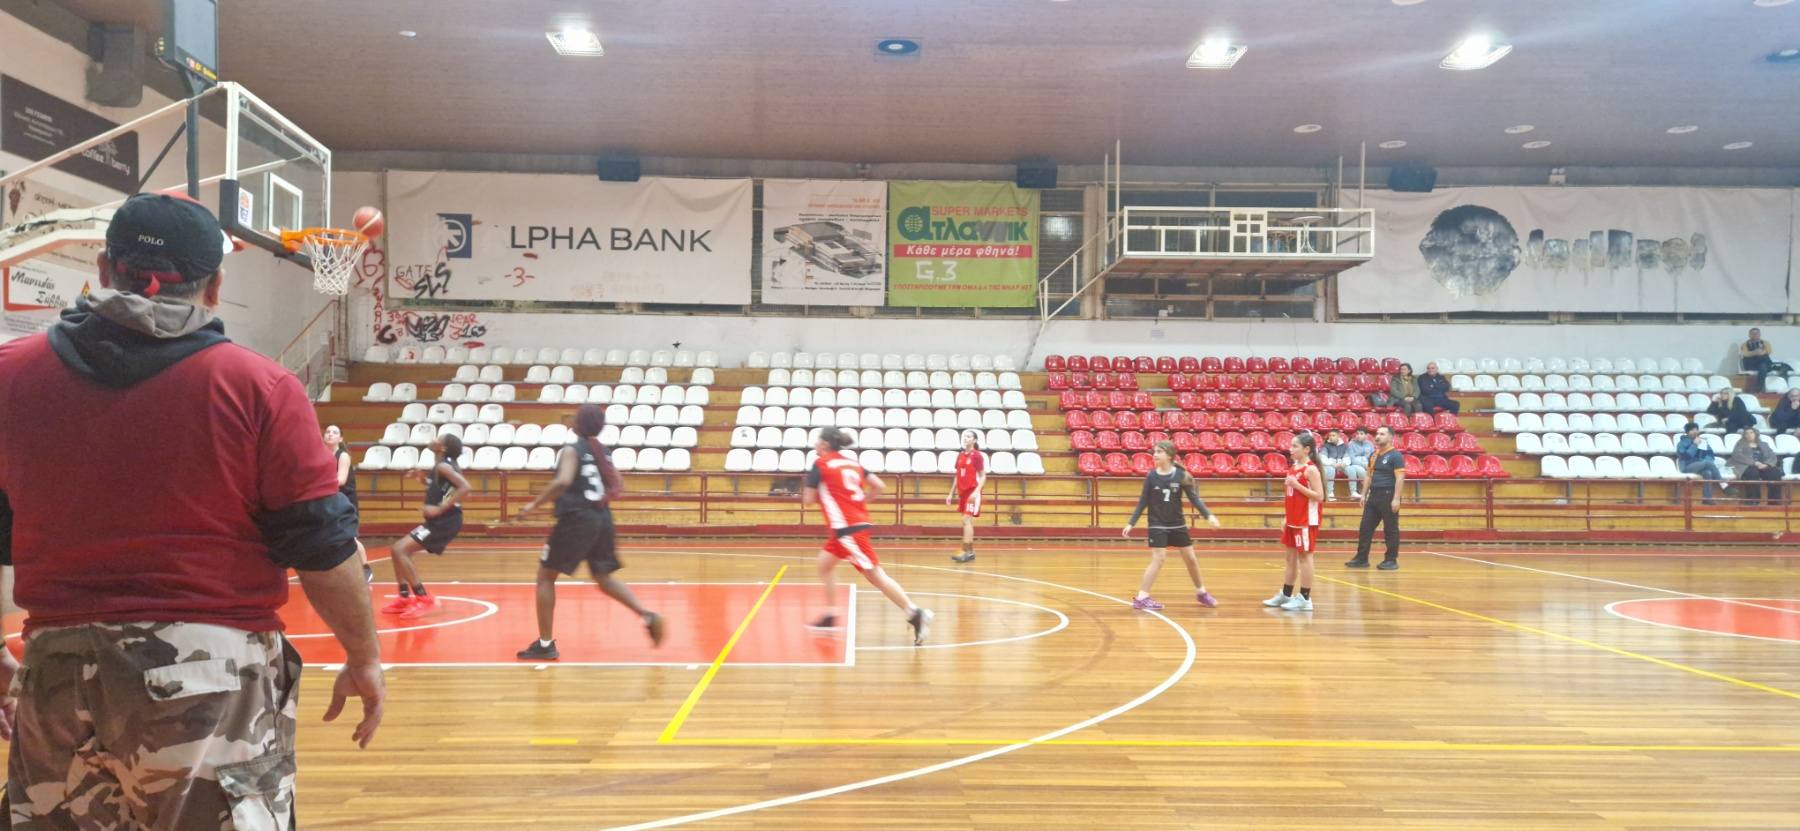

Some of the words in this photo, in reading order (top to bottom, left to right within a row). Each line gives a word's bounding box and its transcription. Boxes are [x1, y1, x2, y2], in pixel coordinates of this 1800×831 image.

[931, 206, 971, 217] SUPER
[974, 206, 1029, 217] MARKETS
[138, 234, 164, 246] POLO
[610, 227, 713, 253] BANK
[906, 245, 937, 256] Κάθε
[941, 245, 971, 258] μέρα
[975, 245, 1020, 259] φθηνά!
[581, 463, 605, 501] 3
[1162, 488, 1171, 501] 7
